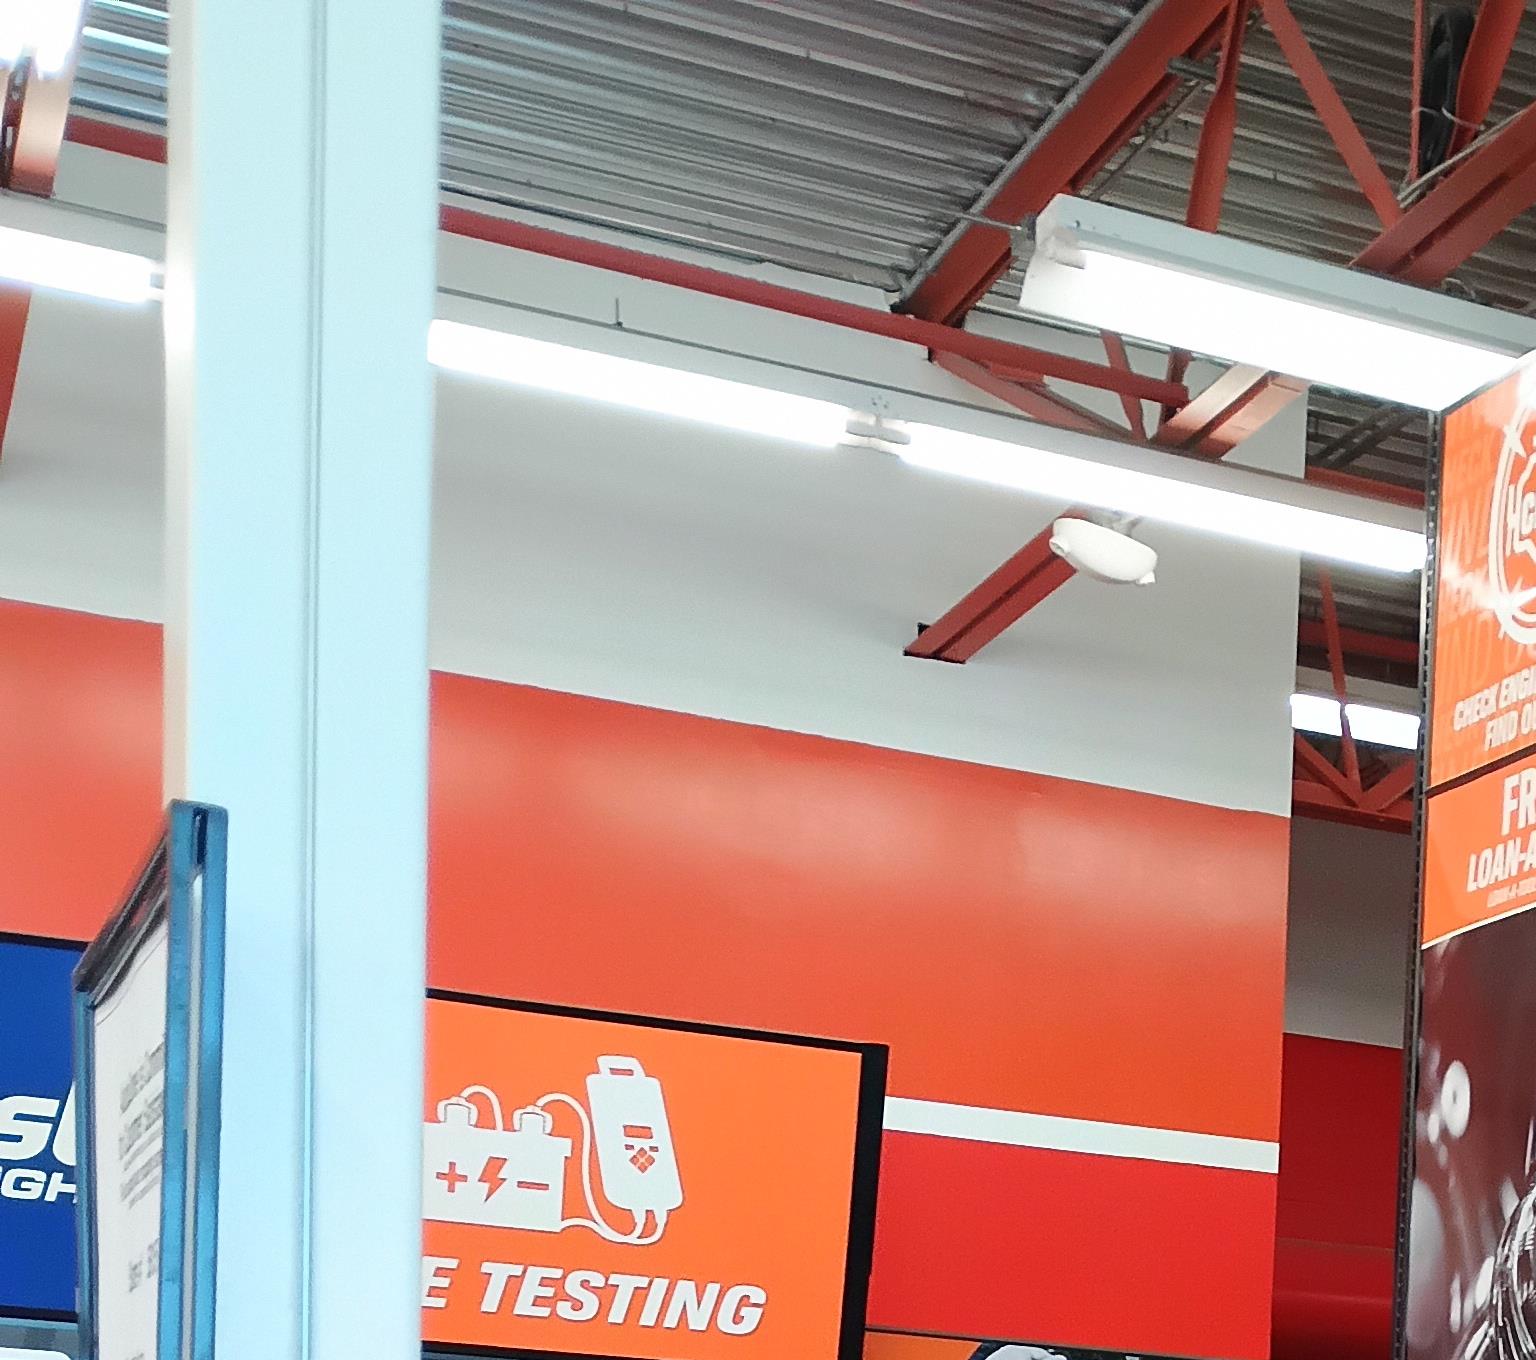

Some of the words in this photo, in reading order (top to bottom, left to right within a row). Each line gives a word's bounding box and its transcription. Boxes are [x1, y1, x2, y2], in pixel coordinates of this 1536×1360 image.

[1453, 682, 1500, 731] CHECK
[1484, 710, 1519, 751] FIND
[479, 1260, 768, 1335] TESTING
